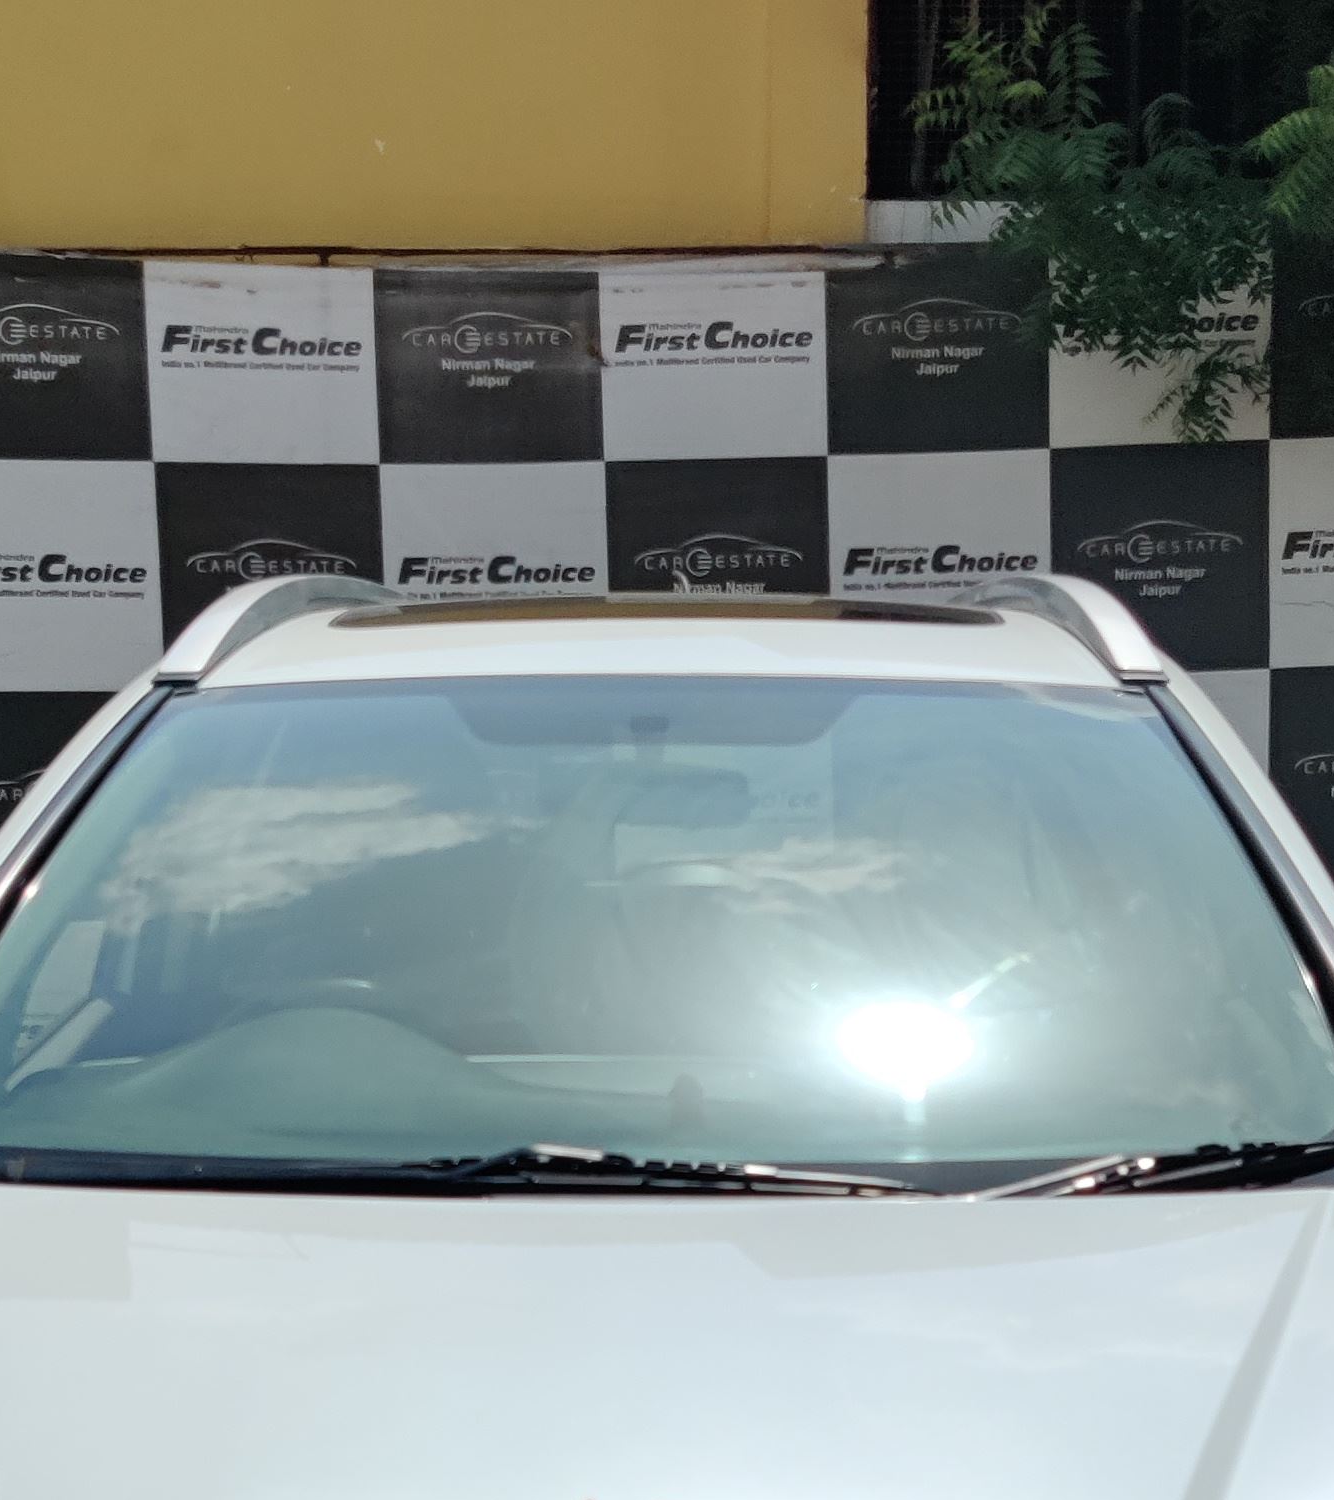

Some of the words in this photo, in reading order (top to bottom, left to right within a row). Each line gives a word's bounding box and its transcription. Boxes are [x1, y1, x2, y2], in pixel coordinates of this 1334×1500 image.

[1191, 312, 1259, 333] oice
[161, 325, 247, 354] First
[252, 327, 362, 356] Choice
[615, 324, 702, 352] First
[704, 321, 813, 350] Choice
[40, 351, 82, 366] Nagar
[891, 347, 939, 360] Nirman
[944, 345, 984, 359] Nagar
[442, 358, 490, 371] Nirman
[495, 358, 536, 372] Nagar
[917, 363, 959, 376] Jaipur
[13, 368, 57, 382] Jaipur
[468, 375, 511, 389] Jaipur
[38, 554, 147, 582] Choice
[843, 548, 929, 576] First
[931, 545, 1038, 573] Choice
[398, 557, 483, 584] First
[487, 556, 596, 584] Choice
[1115, 568, 1162, 581] Nirman
[1167, 567, 1207, 581] Nagar
[1139, 584, 1181, 598] Jaipur
